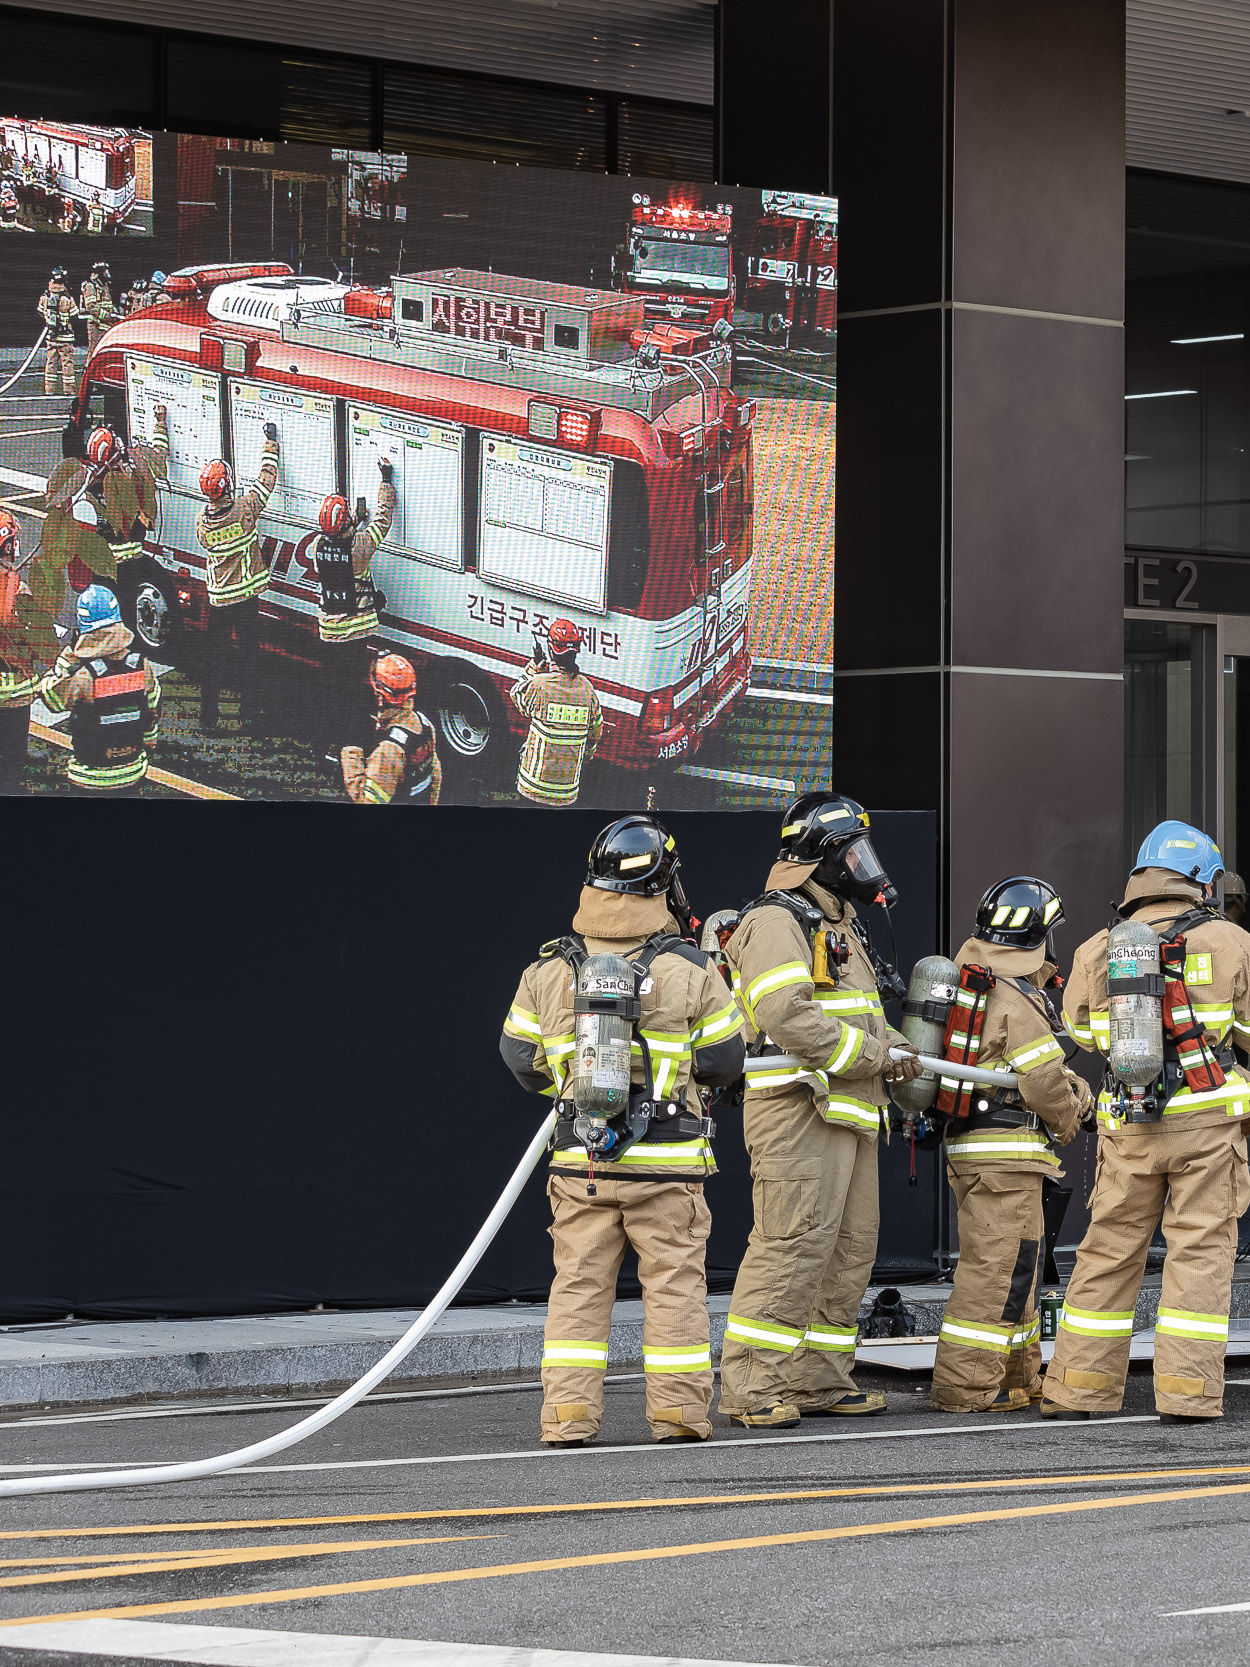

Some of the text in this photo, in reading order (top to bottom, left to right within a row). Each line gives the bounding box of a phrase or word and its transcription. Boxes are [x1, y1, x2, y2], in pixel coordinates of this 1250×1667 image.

[1124, 556, 1199, 608] E 2
[467, 593, 622, 660] 긴급구조제단
[1186, 969, 1209, 983] 센터
